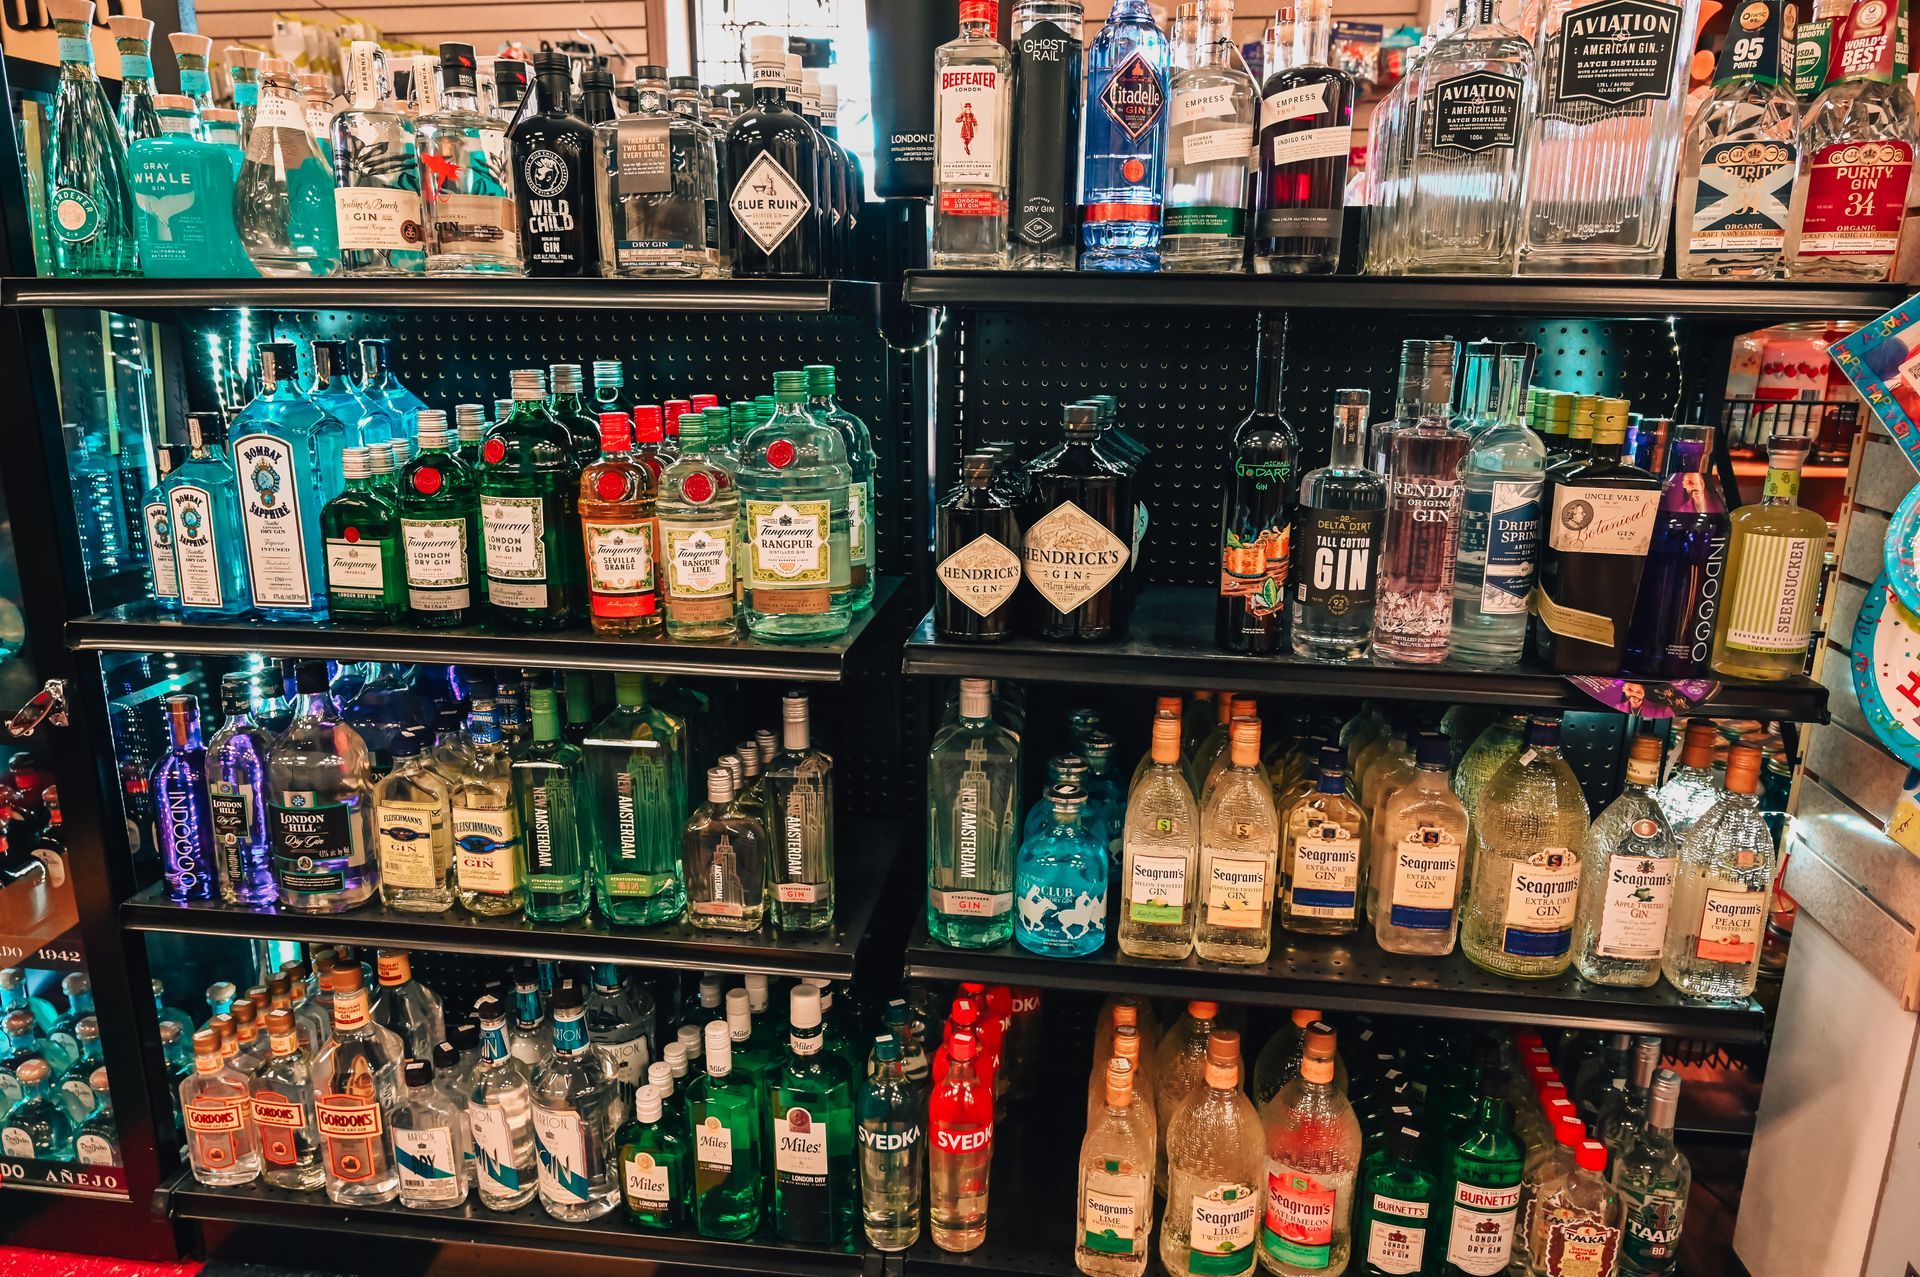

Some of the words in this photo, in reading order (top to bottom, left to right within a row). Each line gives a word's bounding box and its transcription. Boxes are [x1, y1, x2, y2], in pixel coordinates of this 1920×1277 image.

[1571, 14, 1671, 37] AVIATION
[1023, 38, 1067, 54] GHOST
[1733, 38, 1764, 61] 95
[1845, 35, 1888, 50] WORLD'S
[1033, 50, 1059, 61] RAIL
[1583, 44, 1635, 56] AMERICAN
[1841, 45, 1887, 67] BEST
[1610, 59, 1657, 67] DISTILLED
[1733, 61, 1757, 69] POINTS
[942, 72, 996, 90] BEEFEATER
[1109, 83, 1160, 106] Citadelle
[1442, 84, 1517, 101] AVIATION
[1185, 94, 1225, 108] EMPRESS
[1276, 92, 1316, 108] EMPRESS
[1125, 106, 1146, 114] GIN
[1451, 106, 1490, 115] AMERICAN
[891, 134, 928, 144] LONDON
[1187, 135, 1213, 144] CUCUMBER
[143, 162, 169, 170] GRAY
[1723, 166, 1779, 178] PURITY
[1836, 167, 1893, 179] PURITY
[134, 173, 191, 185] WHALE
[1851, 179, 1878, 190] GIN
[53, 191, 94, 213] GARDENER
[530, 199, 570, 216] WILD
[738, 199, 765, 210] BLUE
[768, 199, 798, 210] RUIN
[1844, 192, 1876, 216] 34
[354, 213, 377, 221] GIN
[528, 214, 574, 234] CHILD
[434, 222, 459, 232] GIN
[543, 241, 560, 253] GIN
[244, 446, 283, 465] BOMBAY
[175, 494, 203, 507] BOMBAY
[1408, 499, 1457, 507] ORIGINAL
[1584, 492, 1613, 501] UNCLE
[1616, 493, 1641, 502] VAL'S
[249, 501, 290, 519] SAPPHIRE
[1413, 510, 1450, 522] GIN
[484, 517, 531, 534] Tanqueray
[1318, 520, 1347, 530] DELTA
[1349, 521, 1371, 533] DIRT
[1574, 503, 1650, 545] Botanical
[760, 525, 814, 539] Tanqueray
[179, 537, 209, 547] SAPPHIRE
[408, 536, 458, 551] Tanqueray
[488, 536, 521, 545] LONDON
[761, 539, 813, 549] RANGPUR
[1316, 536, 1338, 547] TALL
[1340, 536, 1370, 548] COTTON
[597, 544, 643, 556] Tanqueray
[678, 548, 723, 560] Tanqueray
[1023, 547, 1119, 565] HENDRICK'S
[332, 557, 377, 571] Tanqueray
[605, 563, 635, 571] ORANGE
[682, 559, 720, 567] RANGPUR
[1314, 549, 1370, 591] GIN
[944, 565, 1020, 581] HENDRICK'S
[1052, 570, 1082, 580] GIN
[972, 584, 998, 593] GIN
[1777, 541, 1806, 634] SEERSUCKER
[1692, 537, 1726, 662] INDOGGO
[1734, 632, 1770, 641] SOUTHERN
[617, 772, 633, 793] NEW
[213, 799, 243, 809] LONDON
[533, 787, 547, 807] NEW
[961, 788, 978, 810] NEW
[219, 807, 237, 815] HILL
[280, 813, 325, 824] LONDON
[384, 814, 423, 827] FLEISCHMANN'S
[289, 823, 317, 832] HILL
[454, 821, 503, 837] FLEISCHMANN'S
[618, 795, 637, 860] AMSTERDAM
[168, 791, 197, 889] INDOGGO
[284, 835, 304, 848] Dry
[305, 836, 325, 848] Gin
[535, 807, 553, 868] AMSTERDAM
[391, 845, 417, 853] GIN
[787, 816, 803, 875] AMSTERDAM
[960, 811, 978, 879] AMSTERDAM
[1298, 846, 1356, 864] Seagram's
[464, 859, 494, 869] GIN
[1400, 855, 1456, 872] Seagram's
[1134, 864, 1185, 881] Seagram's
[1213, 868, 1264, 885] Seagram's
[1314, 872, 1337, 880] GIN
[1613, 869, 1672, 887] Seagram's
[713, 865, 724, 902] AMSTERDAM
[1415, 881, 1437, 889] GIN
[1516, 876, 1579, 897] Seagram's
[787, 890, 805, 898] GIN
[1148, 887, 1167, 896] GIN
[1227, 891, 1246, 900] GIN
[958, 900, 981, 910] GIN
[1552, 897, 1570, 905] DRY
[1614, 900, 1636, 909] APPLE
[1637, 902, 1664, 910] TWISTED
[1536, 905, 1561, 916] GIN
[1630, 909, 1649, 919] GIN
[1707, 900, 1761, 917] Seagram's
[1715, 917, 1751, 927] PEACH
[38, 948, 81, 962] 1942
[191, 1111, 234, 1124] GORDON'S
[254, 1104, 294, 1119] GORDON'S
[320, 1110, 374, 1127] GORDON'S
[700, 1135, 729, 1149] Miles'
[858, 1124, 921, 1150] SVEDKA
[781, 1136, 820, 1153] Miles'
[412, 1153, 435, 1175] DRY
[539, 1150, 572, 1184] GIN
[46, 1168, 117, 1189] AÑEJO
[630, 1176, 665, 1192] Miles'
[1270, 1186, 1331, 1216] Seagram's
[1459, 1189, 1518, 1206] BURNETT'S
[1088, 1198, 1134, 1216] Seagram's
[1376, 1200, 1426, 1217] BURNETT'S
[1099, 1215, 1121, 1224] LIME
[1196, 1205, 1255, 1228] Seagram's
[1269, 1205, 1329, 1226] WATERMELON
[1214, 1225, 1240, 1235] LIME
[1383, 1240, 1410, 1250] LONDON
[1469, 1234, 1502, 1244] LONDON
[1564, 1231, 1606, 1245] TAAKA
[1651, 1247, 1665, 1256] 80
